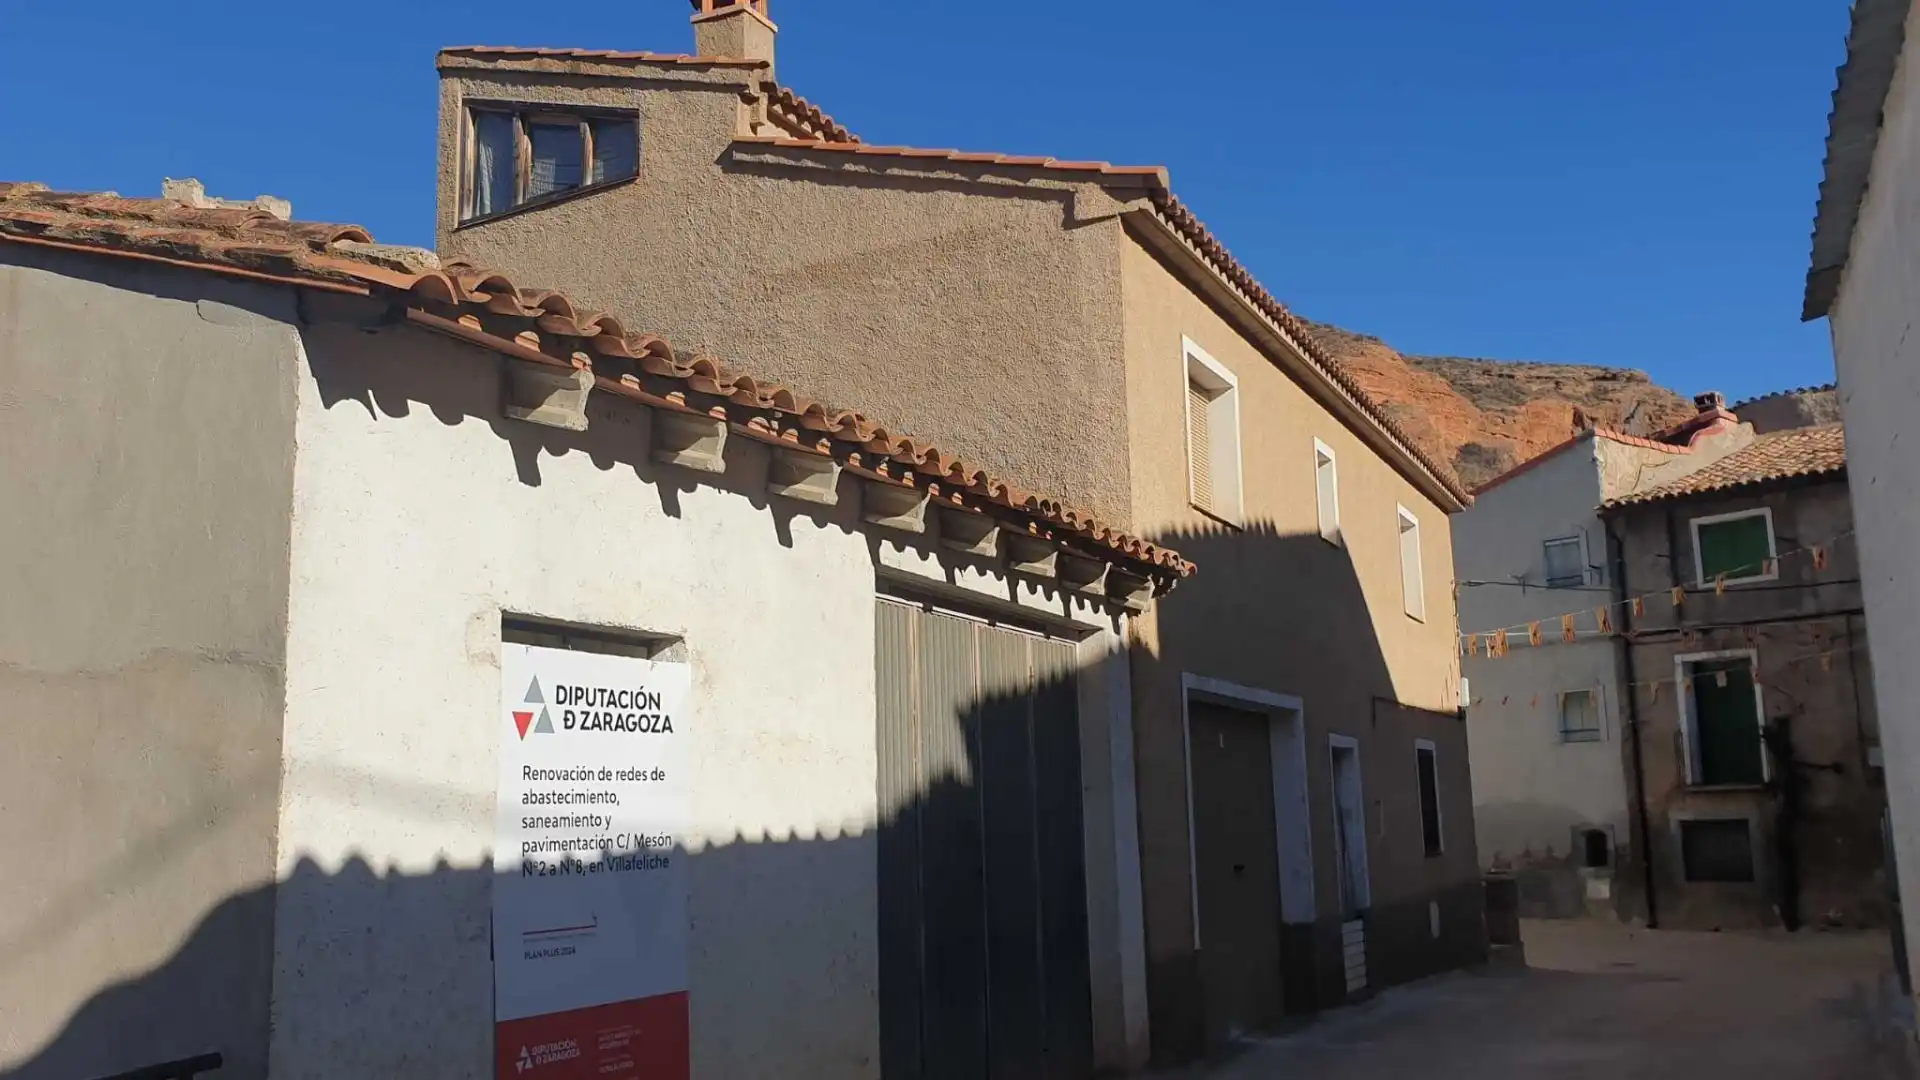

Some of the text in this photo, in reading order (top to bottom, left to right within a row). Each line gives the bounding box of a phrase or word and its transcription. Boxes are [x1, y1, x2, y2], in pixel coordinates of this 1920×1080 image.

[556, 685, 661, 711] DIPUTACIÓN
[580, 711, 673, 734] ZARAGOZA
[523, 765, 666, 781] Renovación de redes de
[522, 789, 620, 806] abastecimiento,
[522, 812, 612, 831] saneamiento y
[522, 831, 672, 857] pavimentación C/ Mesón
[549, 863, 557, 876] a
[589, 860, 604, 874] en
[606, 855, 670, 873] Villafeliche
[524, 950, 542, 961] PLAN
